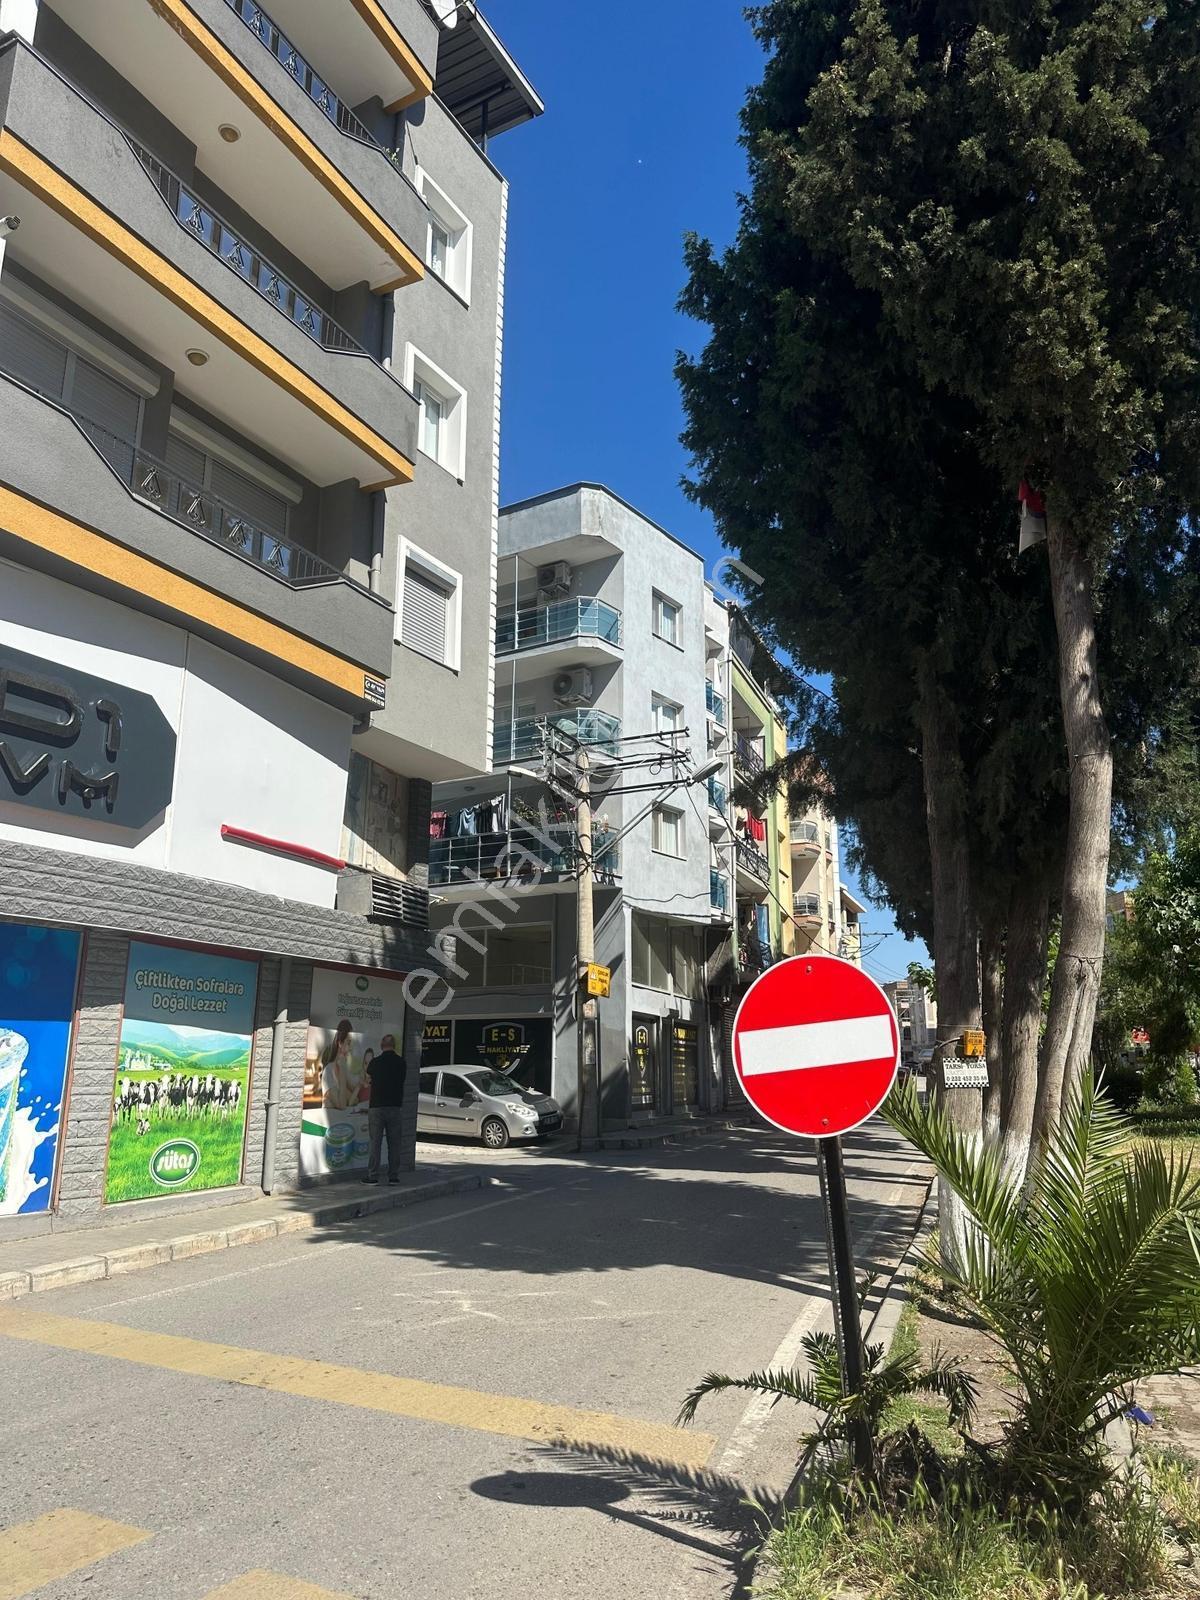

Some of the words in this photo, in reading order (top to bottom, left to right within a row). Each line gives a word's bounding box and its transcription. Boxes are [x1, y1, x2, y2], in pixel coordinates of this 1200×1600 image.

[135, 970, 193, 990] Çiftlikten
[196, 977, 244, 995] Sofralara
[152, 993, 188, 1013] Doğal
[191, 999, 227, 1012] Lezzet
[156, 1149, 195, 1175] sütaş
